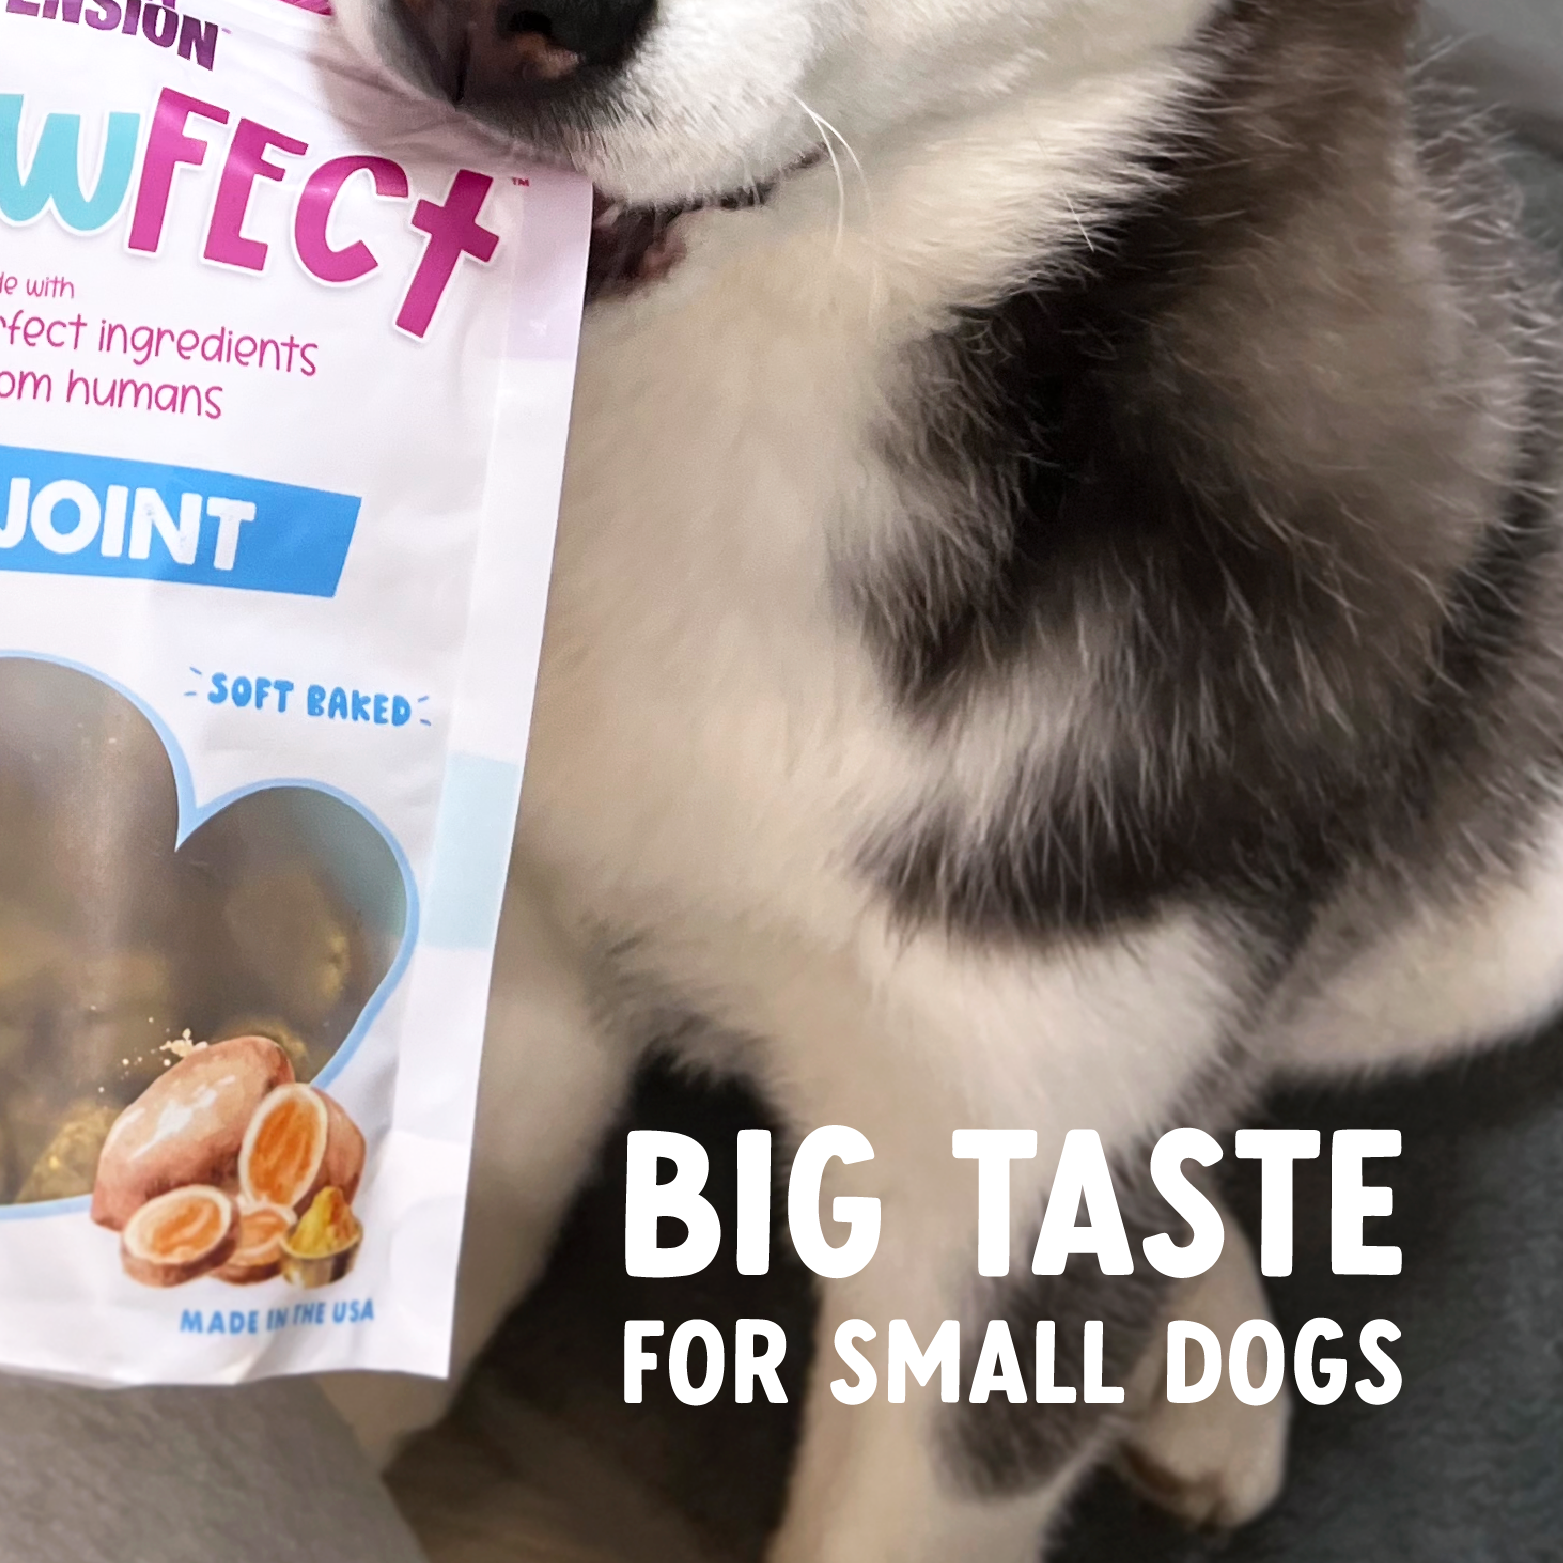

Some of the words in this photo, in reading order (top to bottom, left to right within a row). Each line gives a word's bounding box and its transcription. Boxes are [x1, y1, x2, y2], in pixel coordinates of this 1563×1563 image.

[26, 276, 75, 299] with
[98, 318, 318, 376] ingredients
[66, 369, 223, 420] humans
[208, 672, 294, 713] SOFT
[307, 684, 412, 727] BAKED
[180, 1309, 259, 1335] MADE
[266, 1308, 288, 1331] IN
[293, 1302, 326, 1325] THE
[332, 1298, 375, 1325] USA
